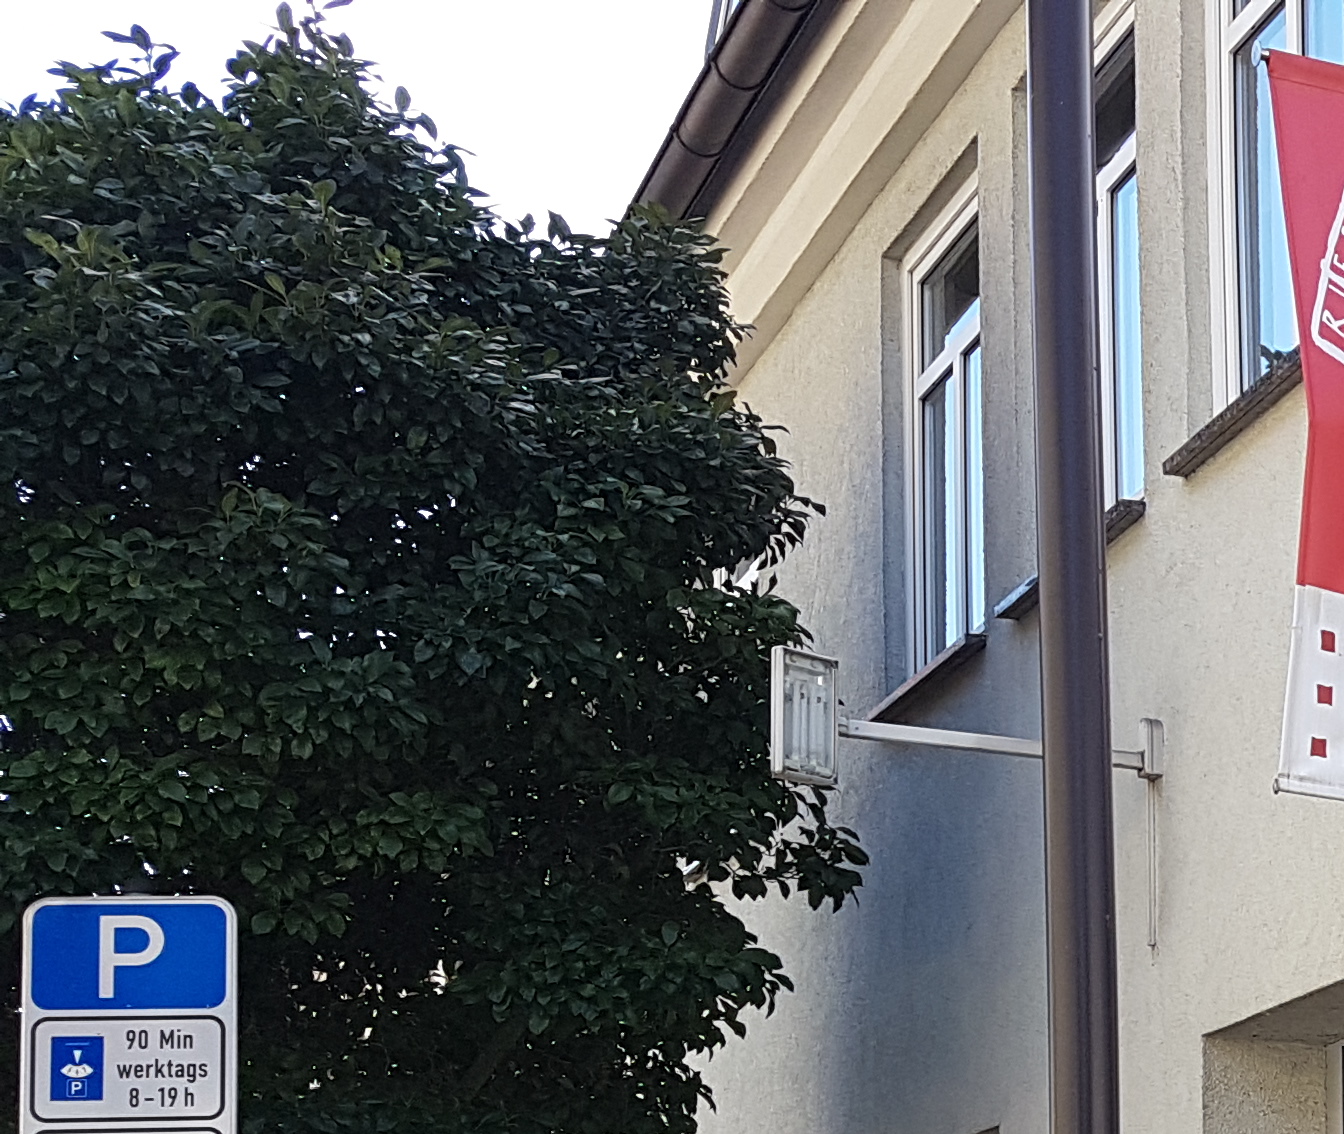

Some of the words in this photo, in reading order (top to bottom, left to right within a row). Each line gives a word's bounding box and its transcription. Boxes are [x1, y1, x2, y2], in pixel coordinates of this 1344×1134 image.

[98, 914, 165, 999] P
[126, 1029, 149, 1050] 90
[159, 1029, 194, 1050] Min
[117, 1058, 208, 1083] werktags
